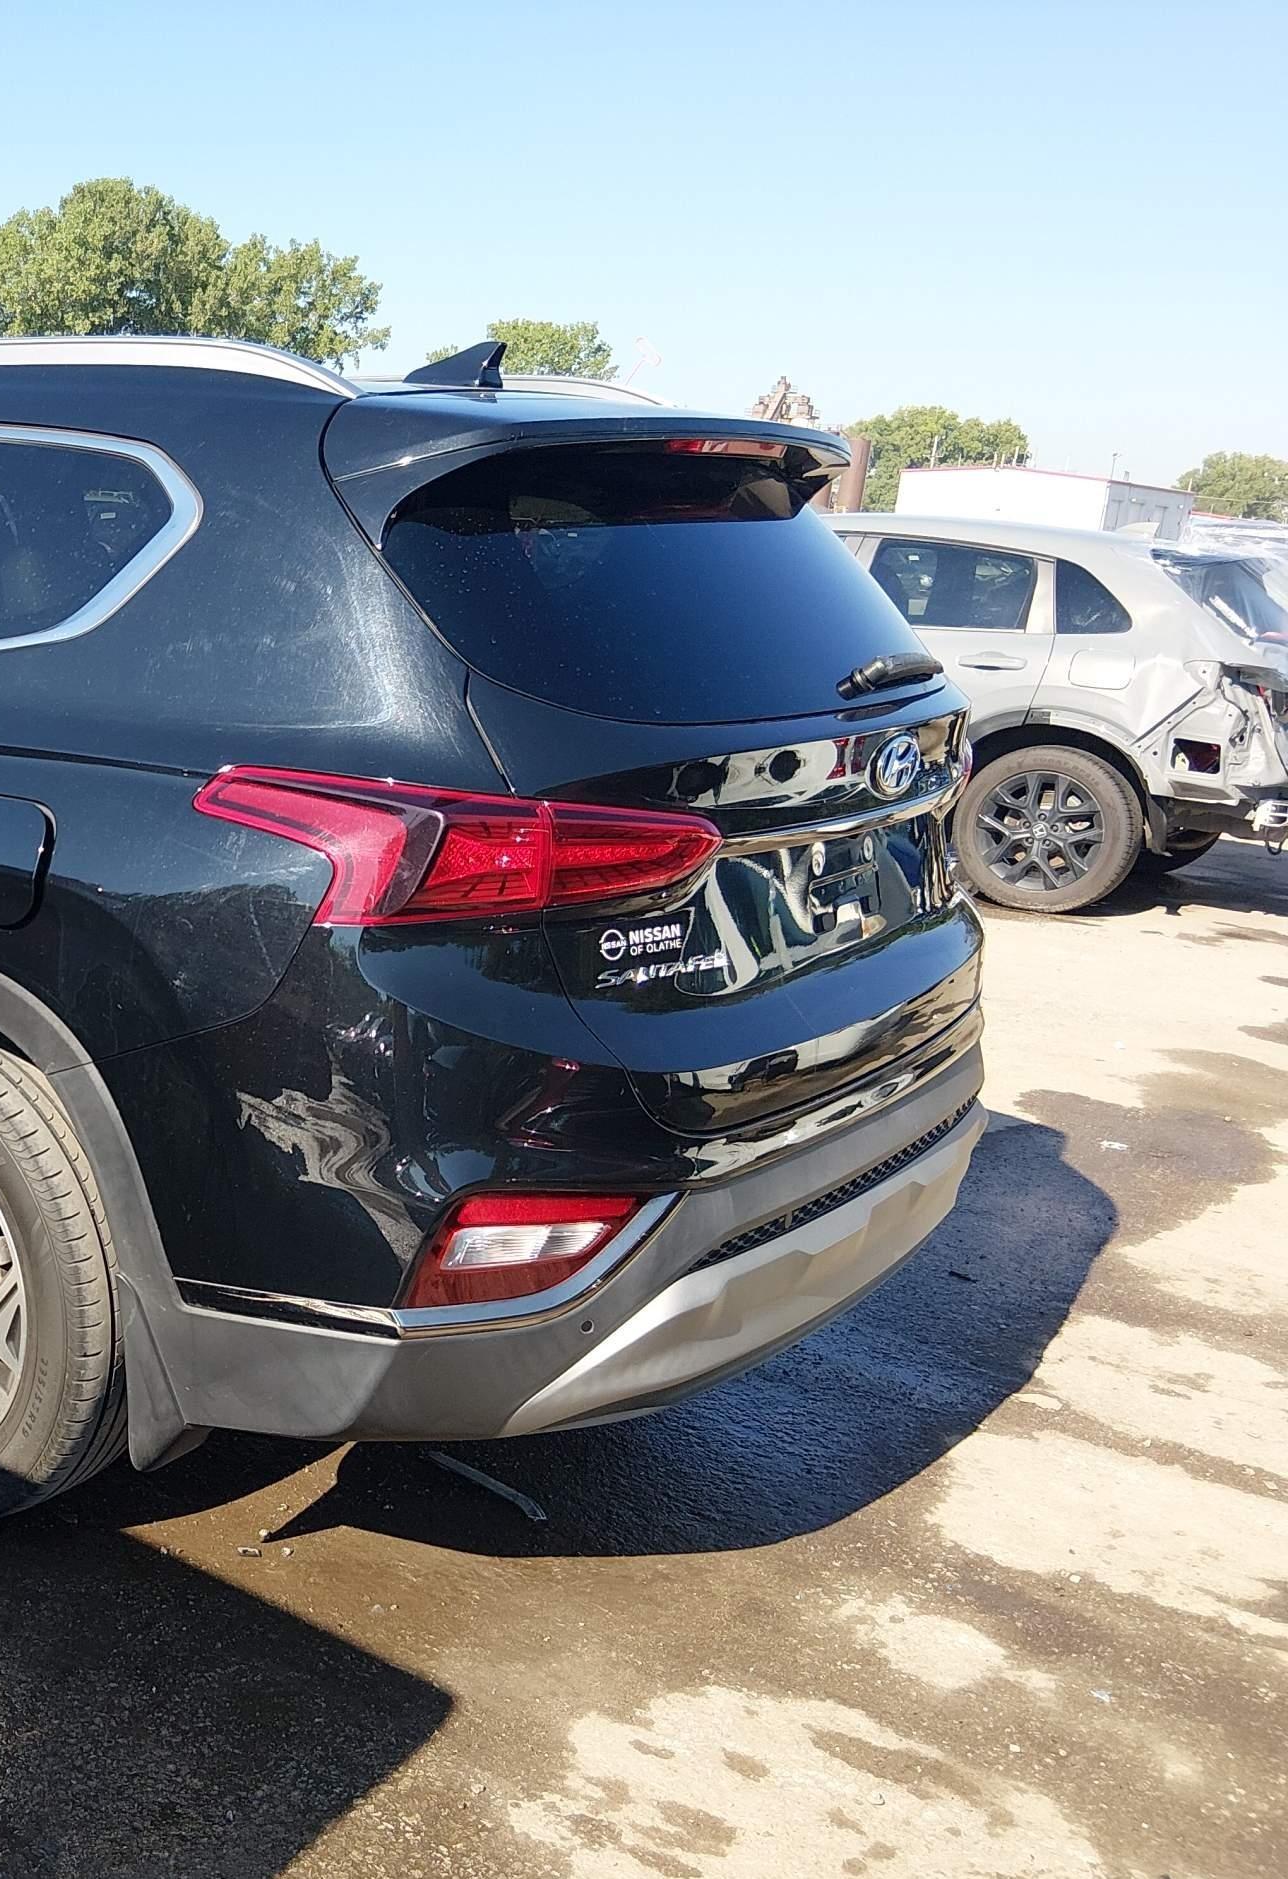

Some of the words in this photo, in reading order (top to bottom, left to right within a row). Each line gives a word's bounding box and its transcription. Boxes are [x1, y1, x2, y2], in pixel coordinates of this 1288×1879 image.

[629, 923, 681, 945] NISSAN
[630, 946, 644, 957] OF
[646, 938, 683, 954] OLATHE
